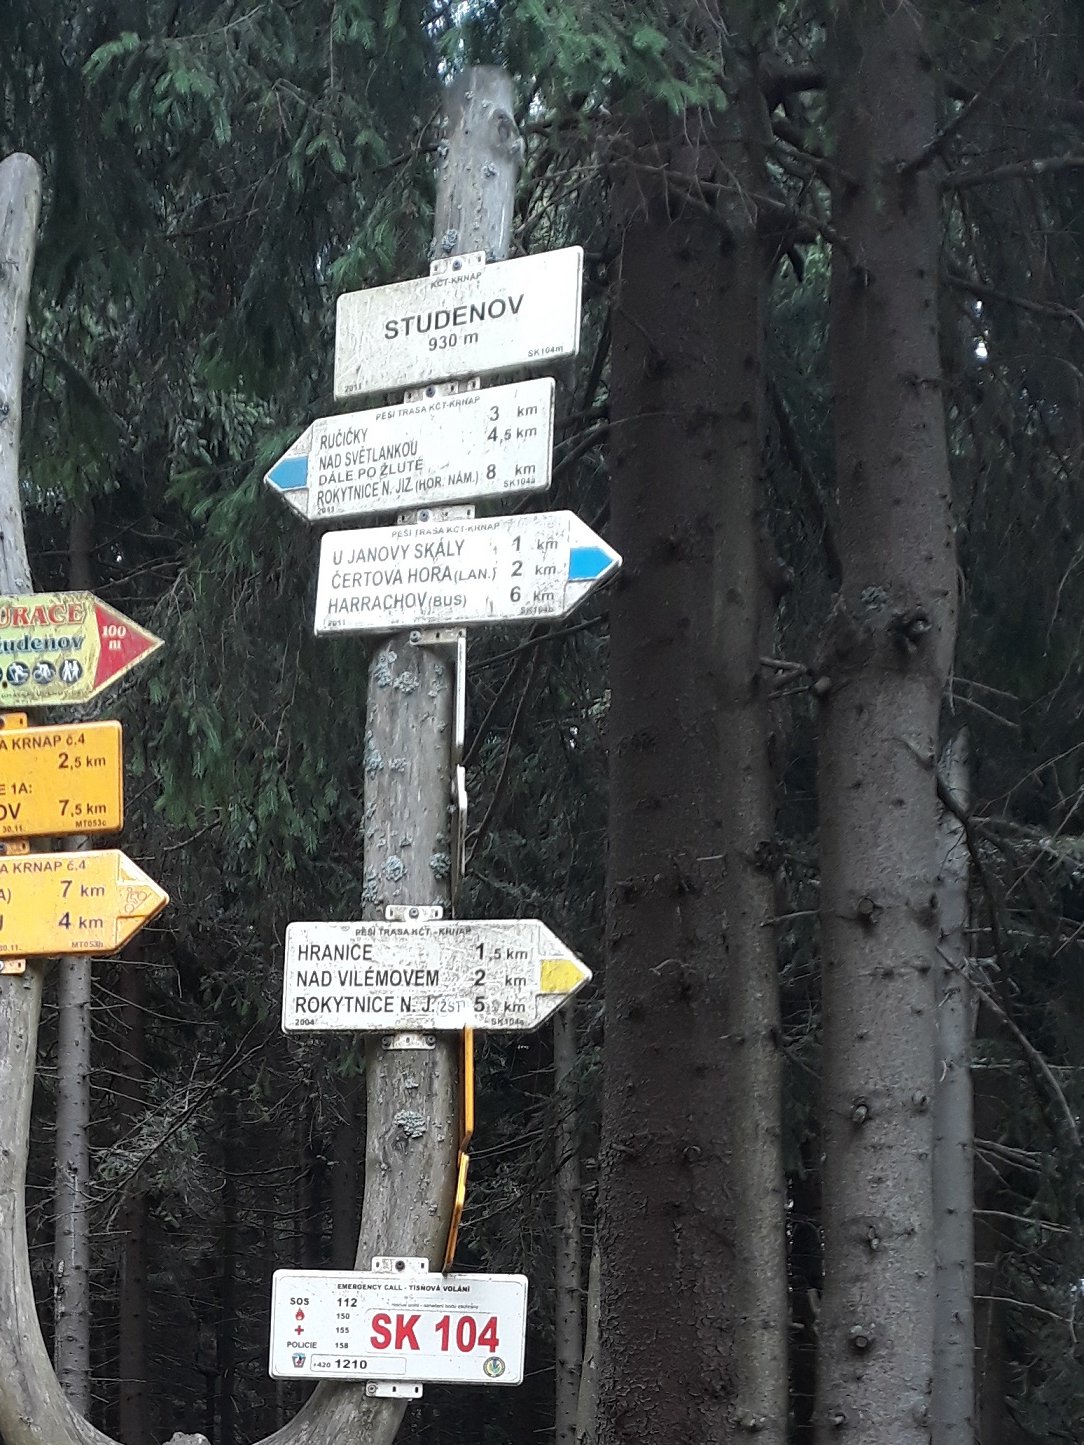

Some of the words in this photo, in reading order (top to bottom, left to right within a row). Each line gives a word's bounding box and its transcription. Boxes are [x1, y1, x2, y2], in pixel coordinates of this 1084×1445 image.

[384, 293, 524, 340] STUDENOV
[428, 333, 458, 352] 930
[464, 331, 479, 345] m
[398, 405, 427, 417] TRASA
[320, 427, 368, 450] RUČIČKY
[489, 405, 500, 422] 3
[517, 405, 538, 418] km
[318, 453, 342, 471] NAD
[344, 440, 418, 467] SVĚTLANKOU
[487, 426, 512, 447] 4,5
[516, 427, 537, 440] km
[318, 469, 354, 486] DÁLE
[358, 466, 377, 479] PO
[317, 481, 379, 507] ROKYTNICE
[381, 480, 392, 496] N.
[486, 464, 496, 480] 8
[515, 464, 536, 476] km
[333, 549, 343, 566] U
[347, 543, 410, 564] JANOVY
[414, 536, 465, 559] SKÁLY
[511, 535, 521, 551] 1
[536, 538, 559, 550] km
[331, 568, 403, 589] ČERTOVA
[510, 560, 523, 577] 2
[534, 564, 557, 576] km
[510, 586, 521, 602] 6
[533, 590, 554, 602] km
[102, 624, 127, 639] 100
[108, 639, 122, 650] m
[12, 735, 62, 751] KRNAP
[58, 752, 82, 770] 2,5
[86, 755, 106, 768] km
[11, 782, 33, 795] 1A:
[58, 799, 82, 817] 7,5
[86, 803, 107, 815] km
[13, 861, 63, 874] KRNAP
[66, 859, 86, 872] č.4
[60, 880, 73, 898] 7
[80, 884, 106, 898] km
[58, 911, 72, 930] 4
[78, 916, 104, 929] km
[379, 928, 409, 937] TRASA
[298, 943, 373, 961] HRANICE
[475, 942, 502, 961] 1,5
[506, 948, 528, 960] km
[296, 970, 333, 987] NAD
[338, 965, 440, 987] VILÉMOVEM
[473, 968, 486, 987] 2
[504, 974, 527, 986] km
[295, 995, 395, 1013] ROKYTNICE
[400, 995, 416, 1013] N.
[421, 995, 435, 1013] J.
[474, 995, 486, 1012] 5
[503, 1000, 526, 1012] km
[295, 1018, 315, 1026] 2004
[337, 1283, 382, 1291] EMERGENCY
[290, 1297, 310, 1306] SOS
[337, 1297, 358, 1307] 112
[336, 1312, 350, 1320] 150
[335, 1326, 350, 1334] 155
[370, 1312, 422, 1351] SK
[434, 1314, 500, 1353] 104
[286, 1340, 318, 1349] POLICIE
[334, 1358, 368, 1370] 1210
